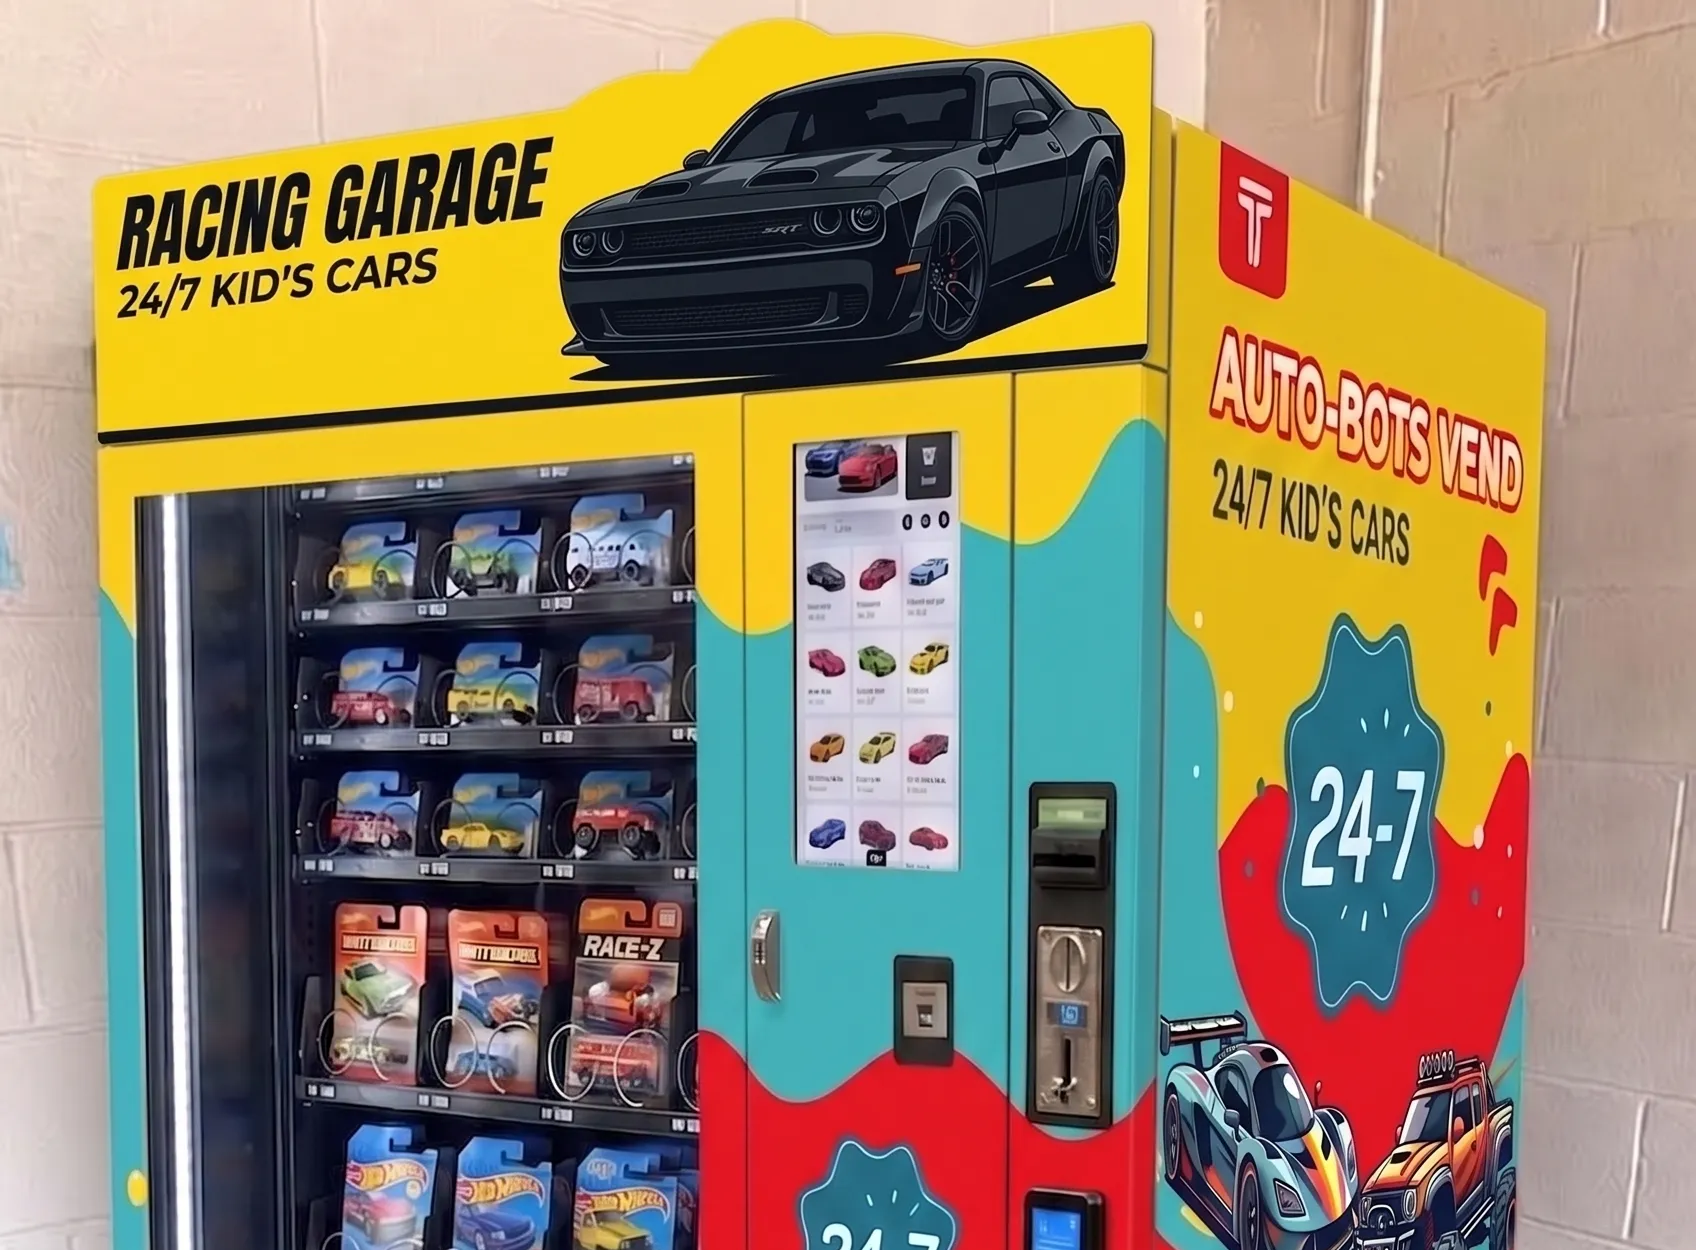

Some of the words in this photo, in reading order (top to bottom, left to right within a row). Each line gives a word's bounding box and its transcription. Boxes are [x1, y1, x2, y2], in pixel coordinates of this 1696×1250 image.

[116, 171, 311, 271] RACING
[324, 136, 555, 242] GARAGE
[116, 276, 199, 320] 24/7
[210, 261, 315, 308] KID'S
[326, 247, 440, 294] CARS
[1209, 325, 1431, 485] AUTO-BOTS
[1437, 407, 1524, 514] VEND
[1212, 458, 1273, 531] 24/7
[1279, 476, 1342, 550] KID'S
[1350, 498, 1411, 566] CARS
[1301, 765, 1426, 888] 24-7
[583, 935, 665, 961] RACE-Z
